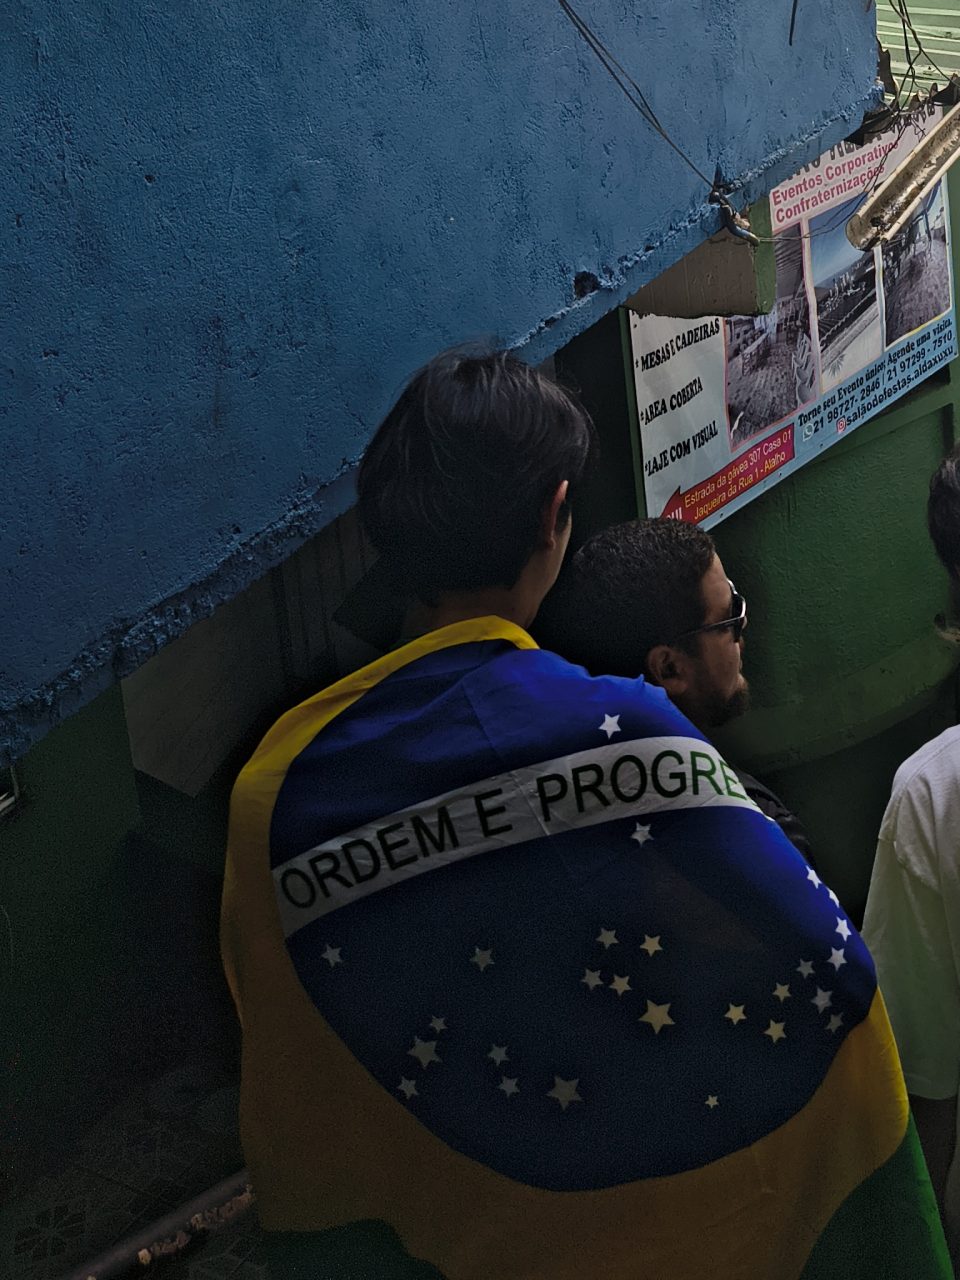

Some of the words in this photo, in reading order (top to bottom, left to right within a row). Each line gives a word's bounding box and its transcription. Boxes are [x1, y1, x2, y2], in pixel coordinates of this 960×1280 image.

[772, 173, 823, 206] Eventos
[825, 139, 899, 181] Corporativos
[775, 163, 885, 223] Confraternizações
[641, 345, 670, 372] MESAS
[670, 338, 676, 357] E
[675, 318, 720, 353] CADEIRAS
[798, 405, 822, 427] Torne
[822, 396, 836, 411] seu
[837, 378, 864, 402] Evento
[887, 341, 915, 366] Agende
[916, 331, 931, 347] uma
[669, 376, 703, 410] COBERTA
[813, 418, 824, 434] 21
[860, 378, 880, 402] 2846
[887, 365, 898, 381] 21
[900, 348, 926, 373] 97299
[932, 330, 952, 351] 7510
[647, 450, 669, 476] LAJE
[669, 438, 691, 462] COM
[692, 420, 719, 449] VISUAL
[684, 483, 715, 508] Estrada
[716, 474, 727, 488] da
[727, 460, 748, 484] gávea
[748, 448, 761, 466] 307
[763, 438, 782, 456] Casa
[782, 429, 791, 442] 01
[694, 492, 726, 520] Jaqueira
[727, 484, 737, 497] da
[738, 474, 753, 490] Rua
[764, 451, 786, 473] Atalho
[280, 807, 460, 909] ORDEM
[474, 788, 514, 838] E
[535, 749, 750, 823] PROGRE
